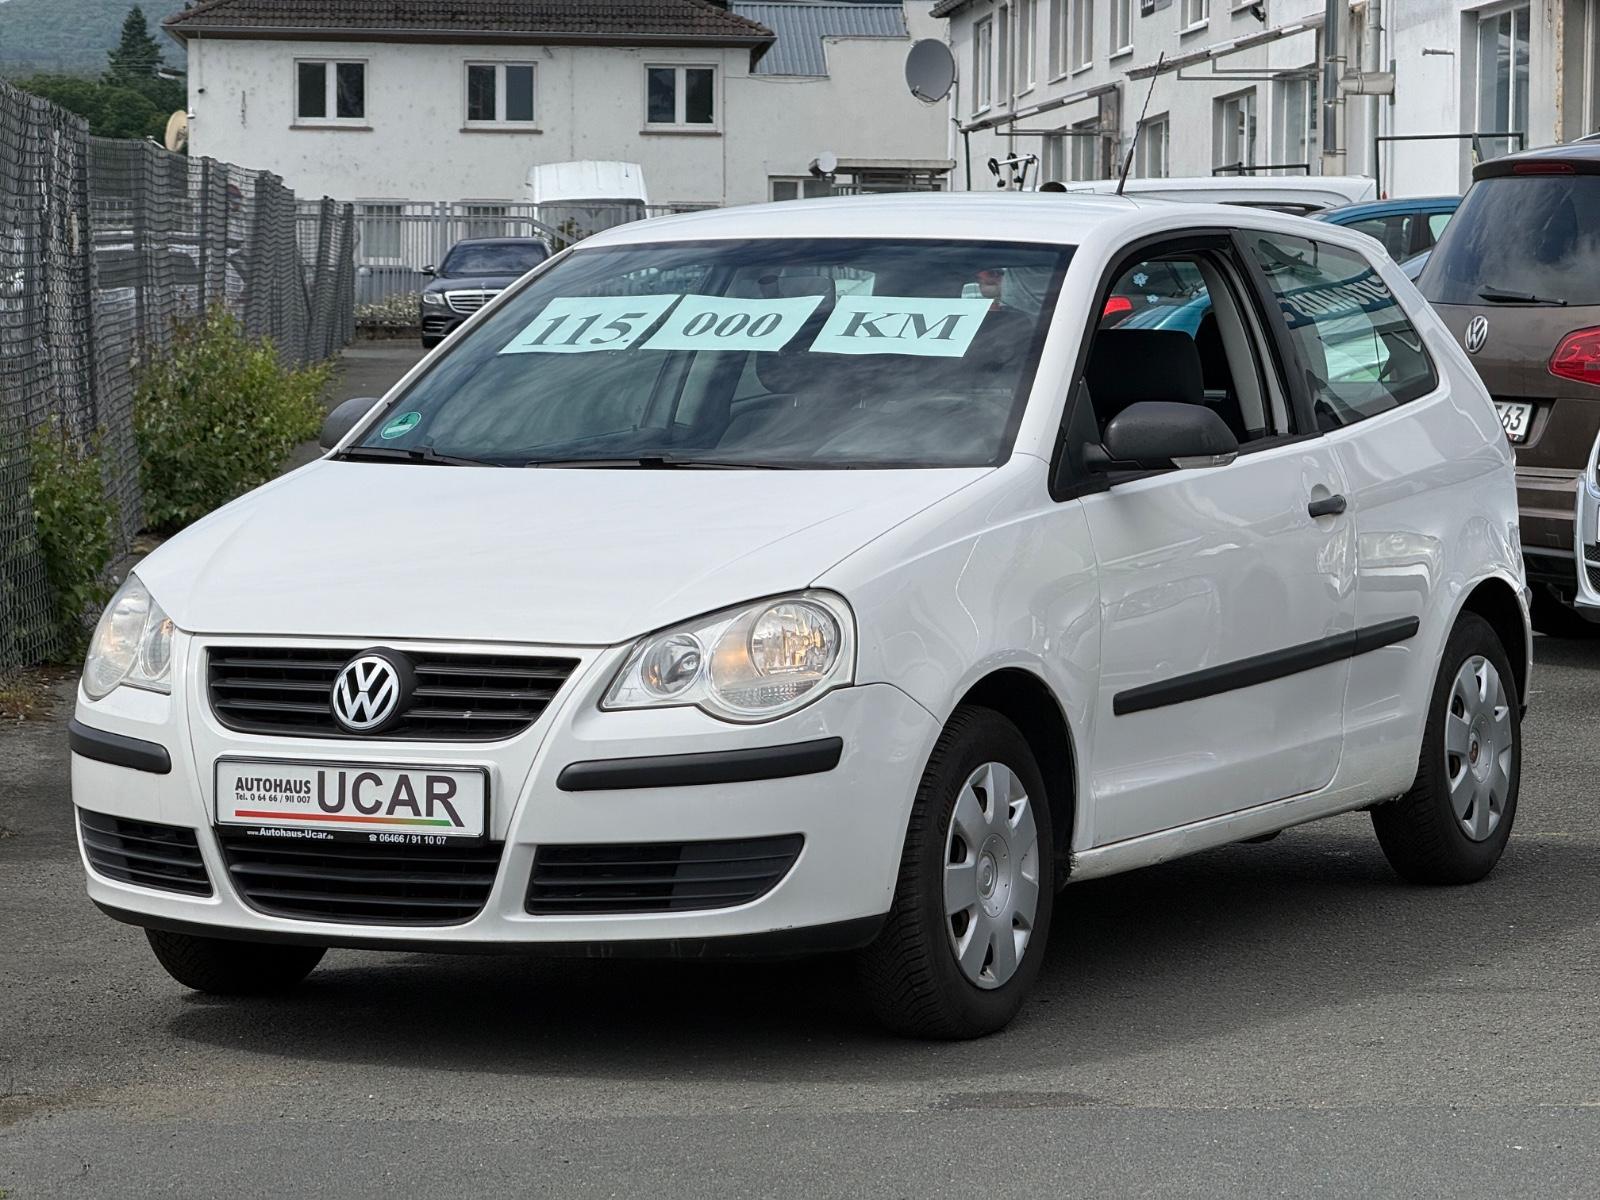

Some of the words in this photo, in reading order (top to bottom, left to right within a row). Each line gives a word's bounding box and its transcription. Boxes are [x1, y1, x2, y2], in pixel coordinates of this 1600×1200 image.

[681, 312, 783, 338] 000
[835, 311, 969, 340] KM
[332, 656, 400, 730] VW
[235, 792, 248, 801] Tel.
[250, 793, 256, 801] 0
[257, 793, 267, 801] 64
[268, 794, 278, 802] 66
[235, 776, 311, 794] AUTOHAUS
[317, 770, 465, 828] UCAR
[379, 833, 404, 844] 06466
[411, 835, 421, 845] 91
[424, 836, 435, 845] 10
[436, 836, 447, 845] 07
